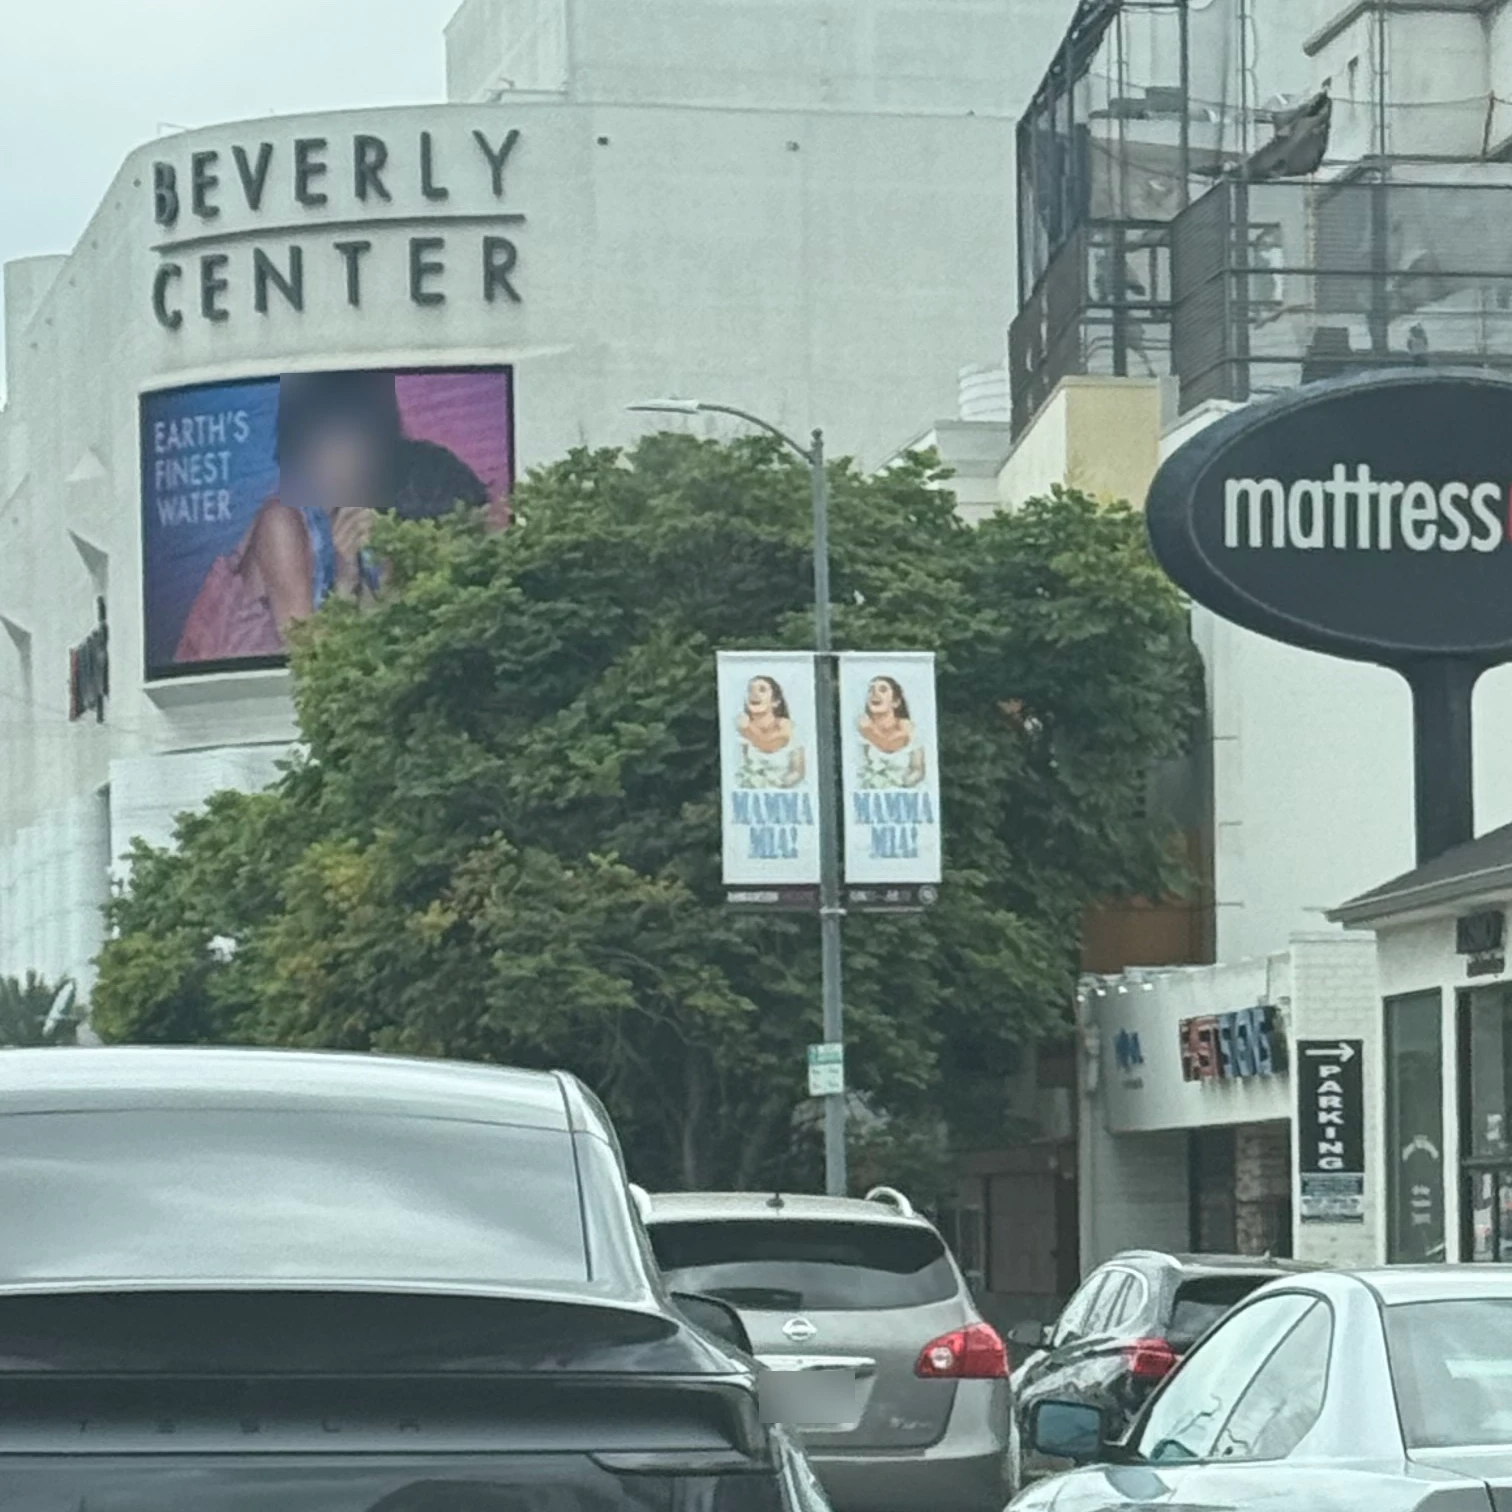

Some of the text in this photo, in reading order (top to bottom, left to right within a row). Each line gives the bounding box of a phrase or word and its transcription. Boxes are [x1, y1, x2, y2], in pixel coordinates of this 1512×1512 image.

[153, 129, 521, 226] BEVERLY
[151, 236, 522, 330] CENTER
[154, 409, 250, 453] EARTH'S
[155, 450, 231, 492] FINEST
[156, 488, 231, 527] WATER
[1223, 463, 1503, 552] mattress
[1317, 1065, 1345, 1170] PARKING
